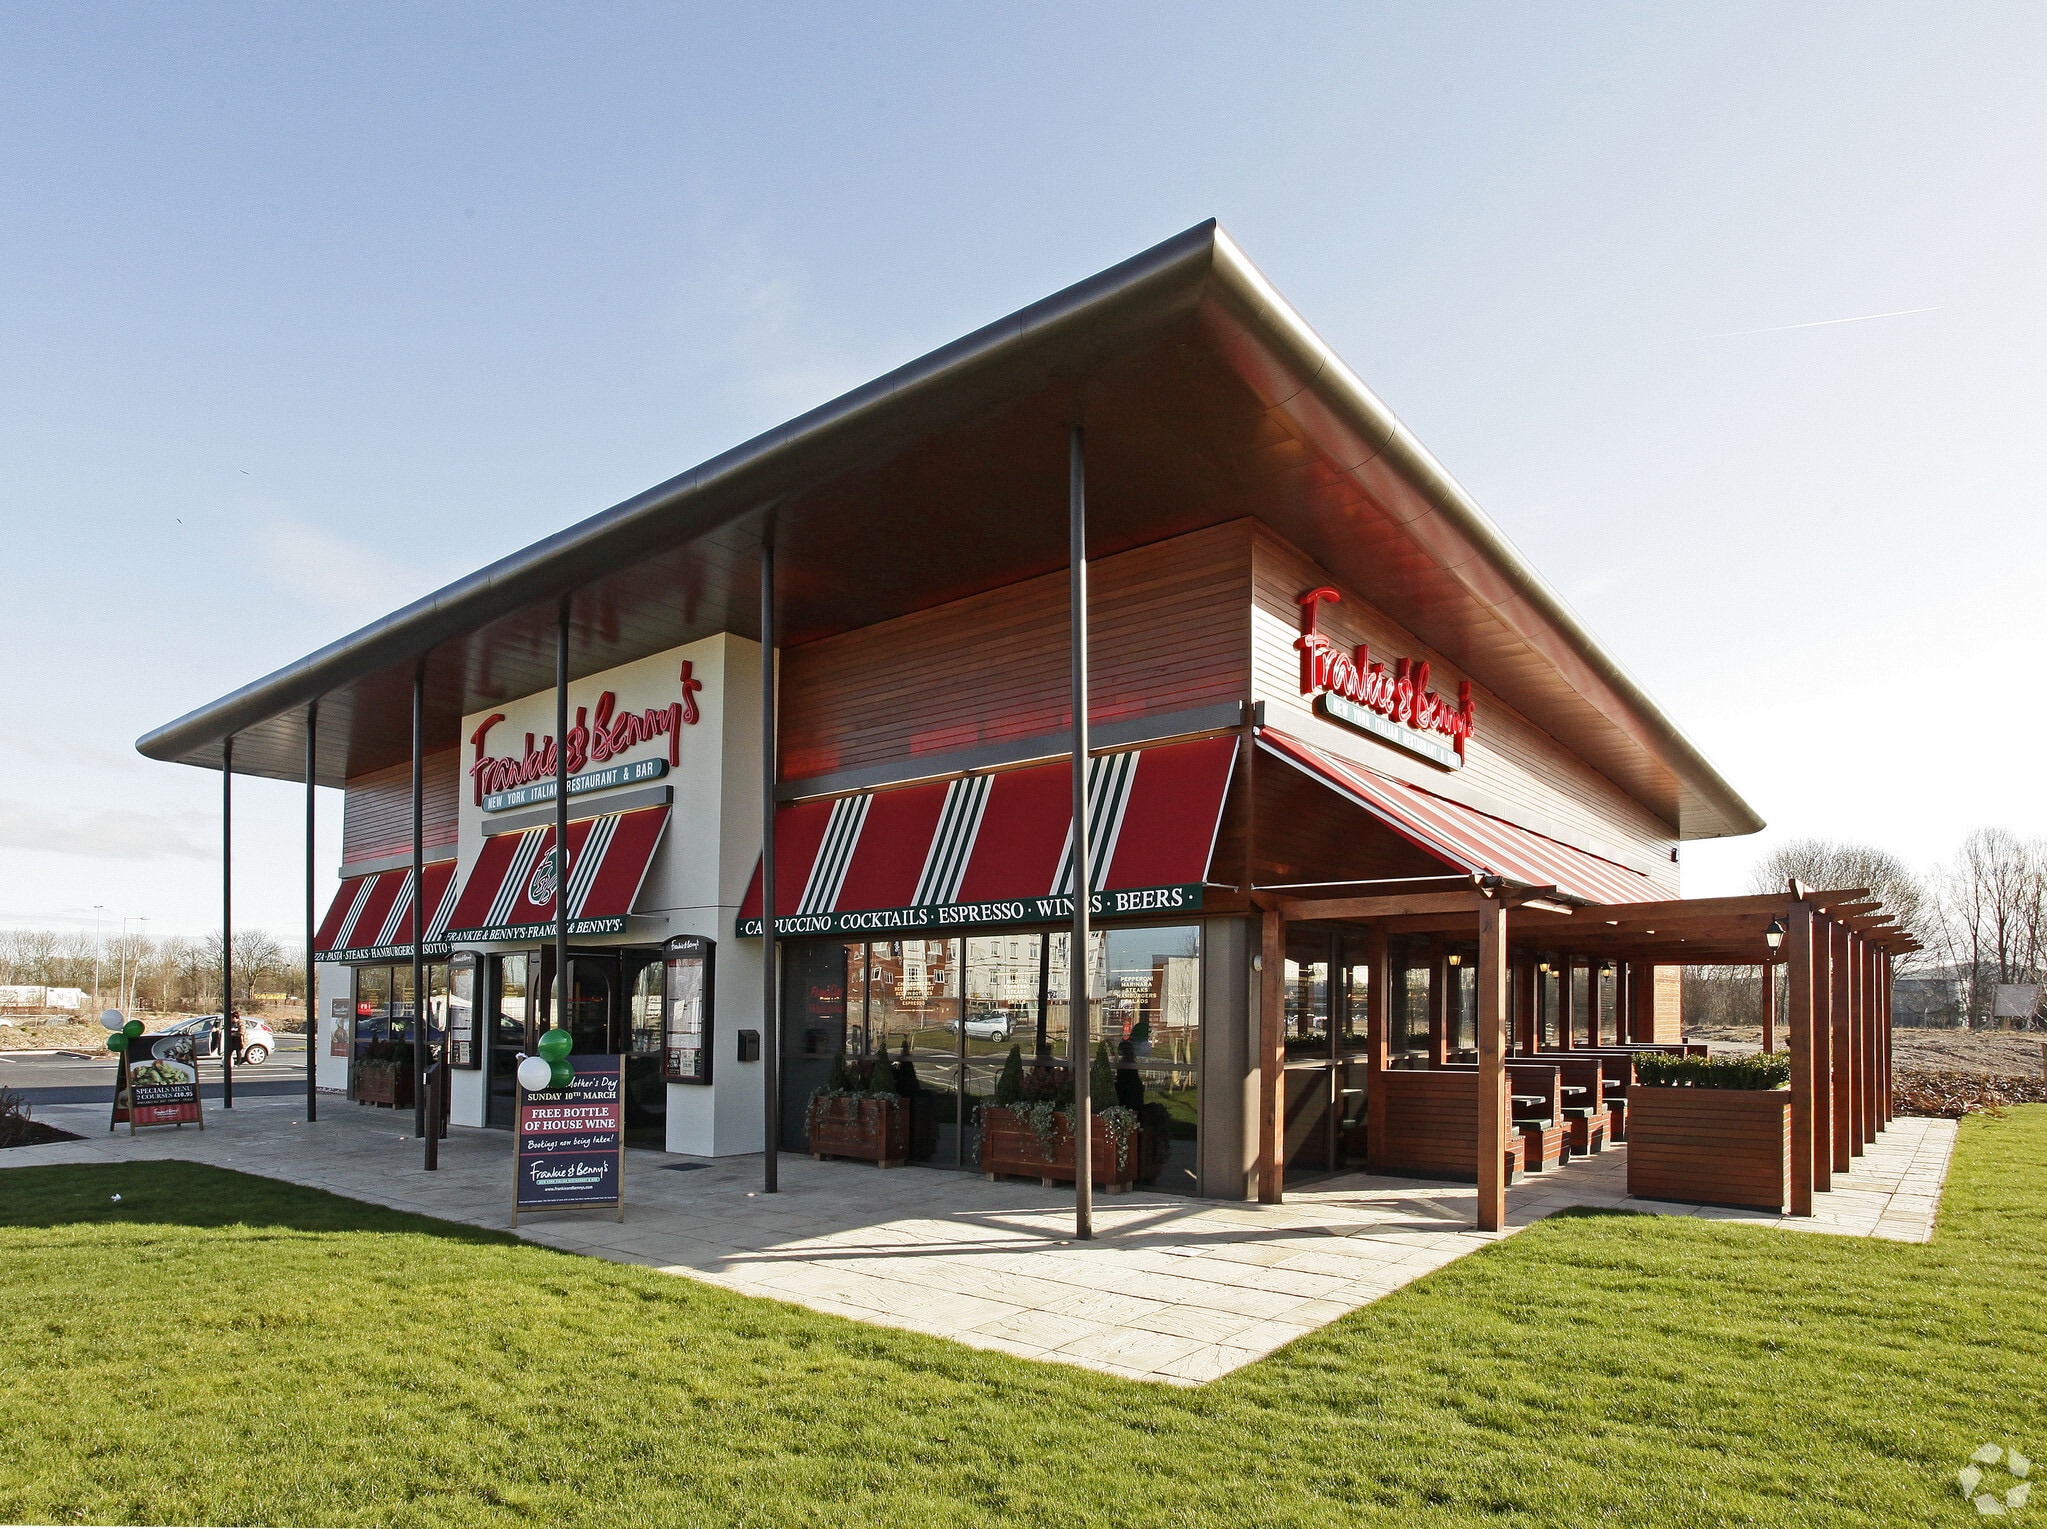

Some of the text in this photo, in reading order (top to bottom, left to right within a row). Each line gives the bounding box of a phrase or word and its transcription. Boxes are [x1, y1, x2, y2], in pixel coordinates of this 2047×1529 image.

[1293, 586, 1394, 714] Frankie
[469, 713, 557, 806] Frankie
[591, 660, 702, 767] Benny's
[487, 796, 504, 810] NEW
[507, 790, 526, 805] YORK
[567, 770, 617, 793] RESTAURANT
[624, 767, 630, 781] &
[636, 762, 653, 778] BAR
[745, 916, 832, 935] CAPUCCINO
[840, 909, 928, 929] COCKTAILS
[938, 902, 1024, 923] ESPRESSO
[1116, 888, 1183, 912] BEERS
[445, 919, 620, 942] FRANKIE & BENNY'S FRANK & BENNY'S
[326, 951, 343, 960] PASTA
[344, 949, 369, 960] STEAKS
[371, 945, 414, 957] HAMBURGERS
[423, 943, 447, 955] ISOTTO
[136, 1087, 170, 1095] SPECIALS
[601, 1076, 618, 1091] Day
[528, 1091, 616, 1101] SUNDAY 10TH MARCH
[531, 1107, 609, 1118] FREE BOTTLE
[525, 1119, 616, 1131] OF HOUSE WINE
[527, 1140, 558, 1151] Bookings
[573, 1137, 590, 1148] being
[593, 1134, 614, 1144] taken!
[530, 1160, 609, 1181] Frankie & Benny's
